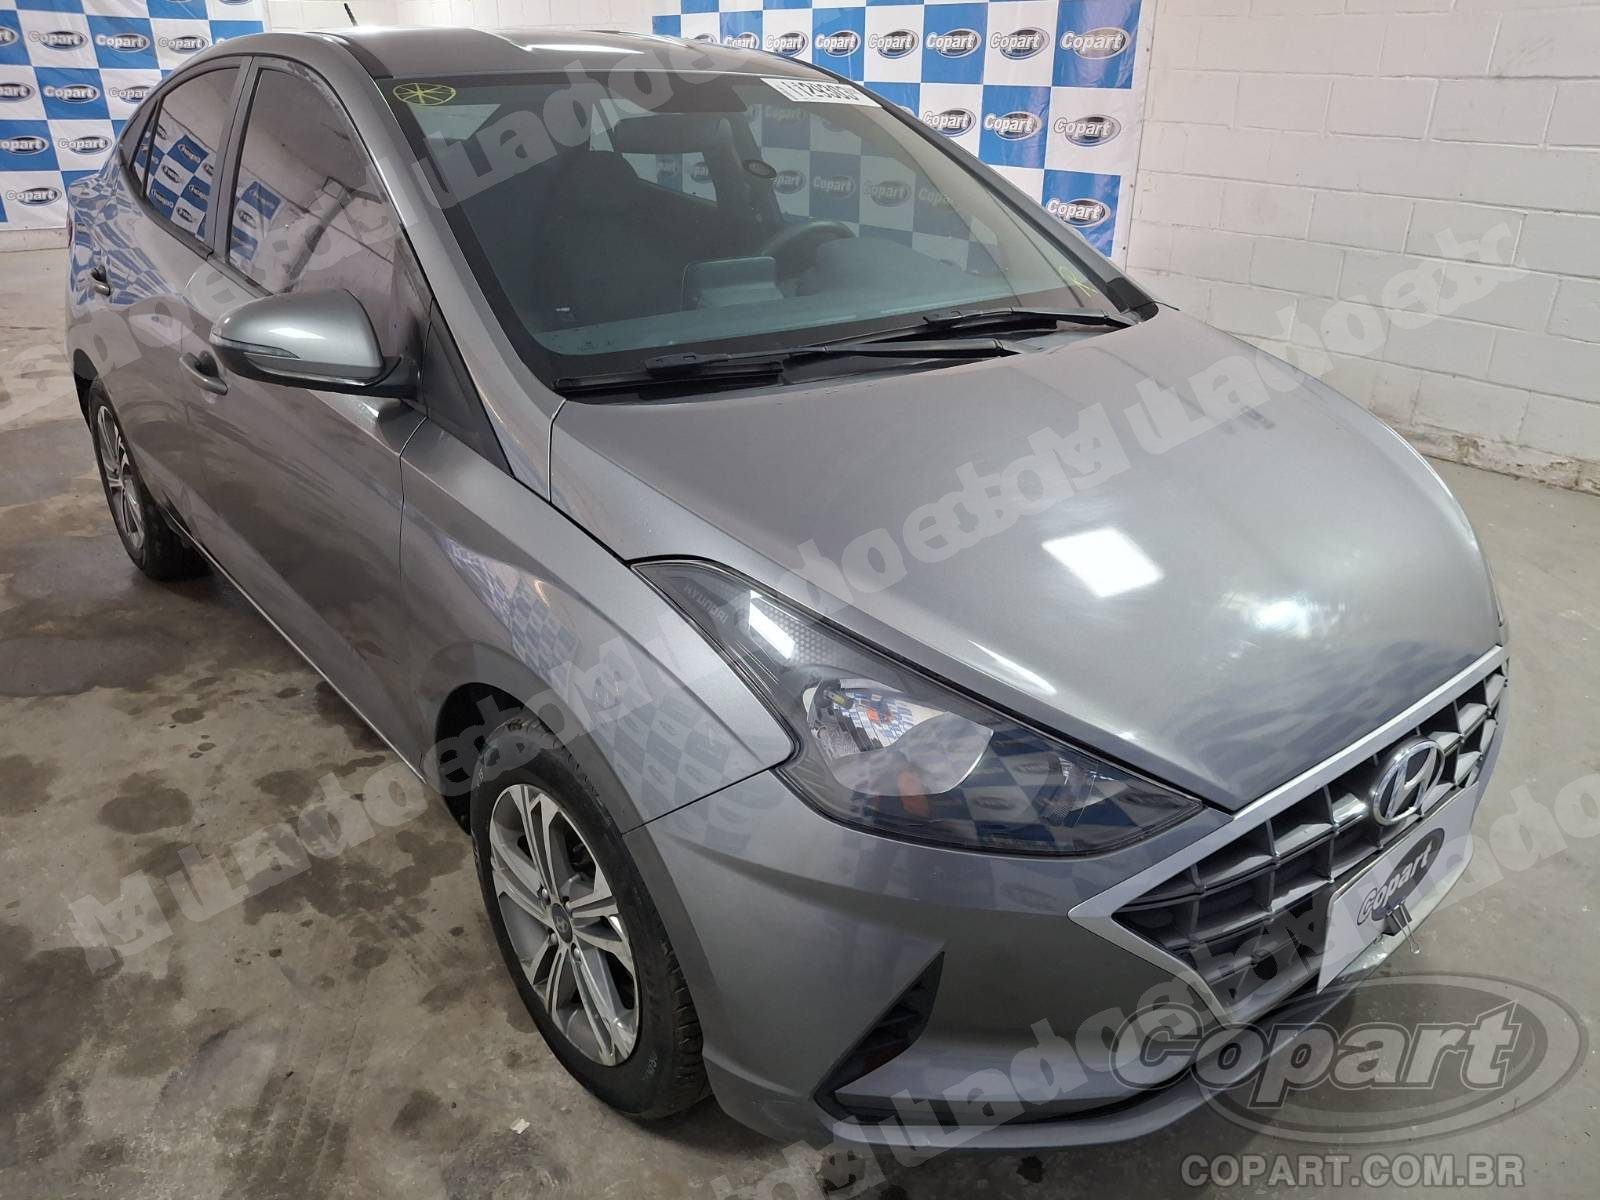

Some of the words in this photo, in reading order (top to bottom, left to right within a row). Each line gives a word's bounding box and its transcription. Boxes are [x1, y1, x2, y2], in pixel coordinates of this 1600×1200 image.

[28, 31, 81, 46] Copart
[95, 34, 145, 47] Copart
[159, 37, 202, 49] Copart
[766, 34, 806, 54] Copart
[815, 34, 857, 52] Copart
[868, 34, 912, 53] Copart
[926, 32, 975, 53] Copart
[990, 32, 1041, 53] Copart
[1060, 31, 1123, 53] Copart
[43, 85, 95, 100] Copart
[922, 111, 970, 131] Copart
[984, 113, 1034, 136] Copart
[1054, 117, 1110, 141] Copart
[0, 139, 42, 152] opart
[58, 138, 106, 151] Copart
[813, 175, 853, 193] Copart
[6, 189, 56, 203] Copart
[1046, 198, 1101, 221] Copart
[1357, 841, 1435, 926] Copart
